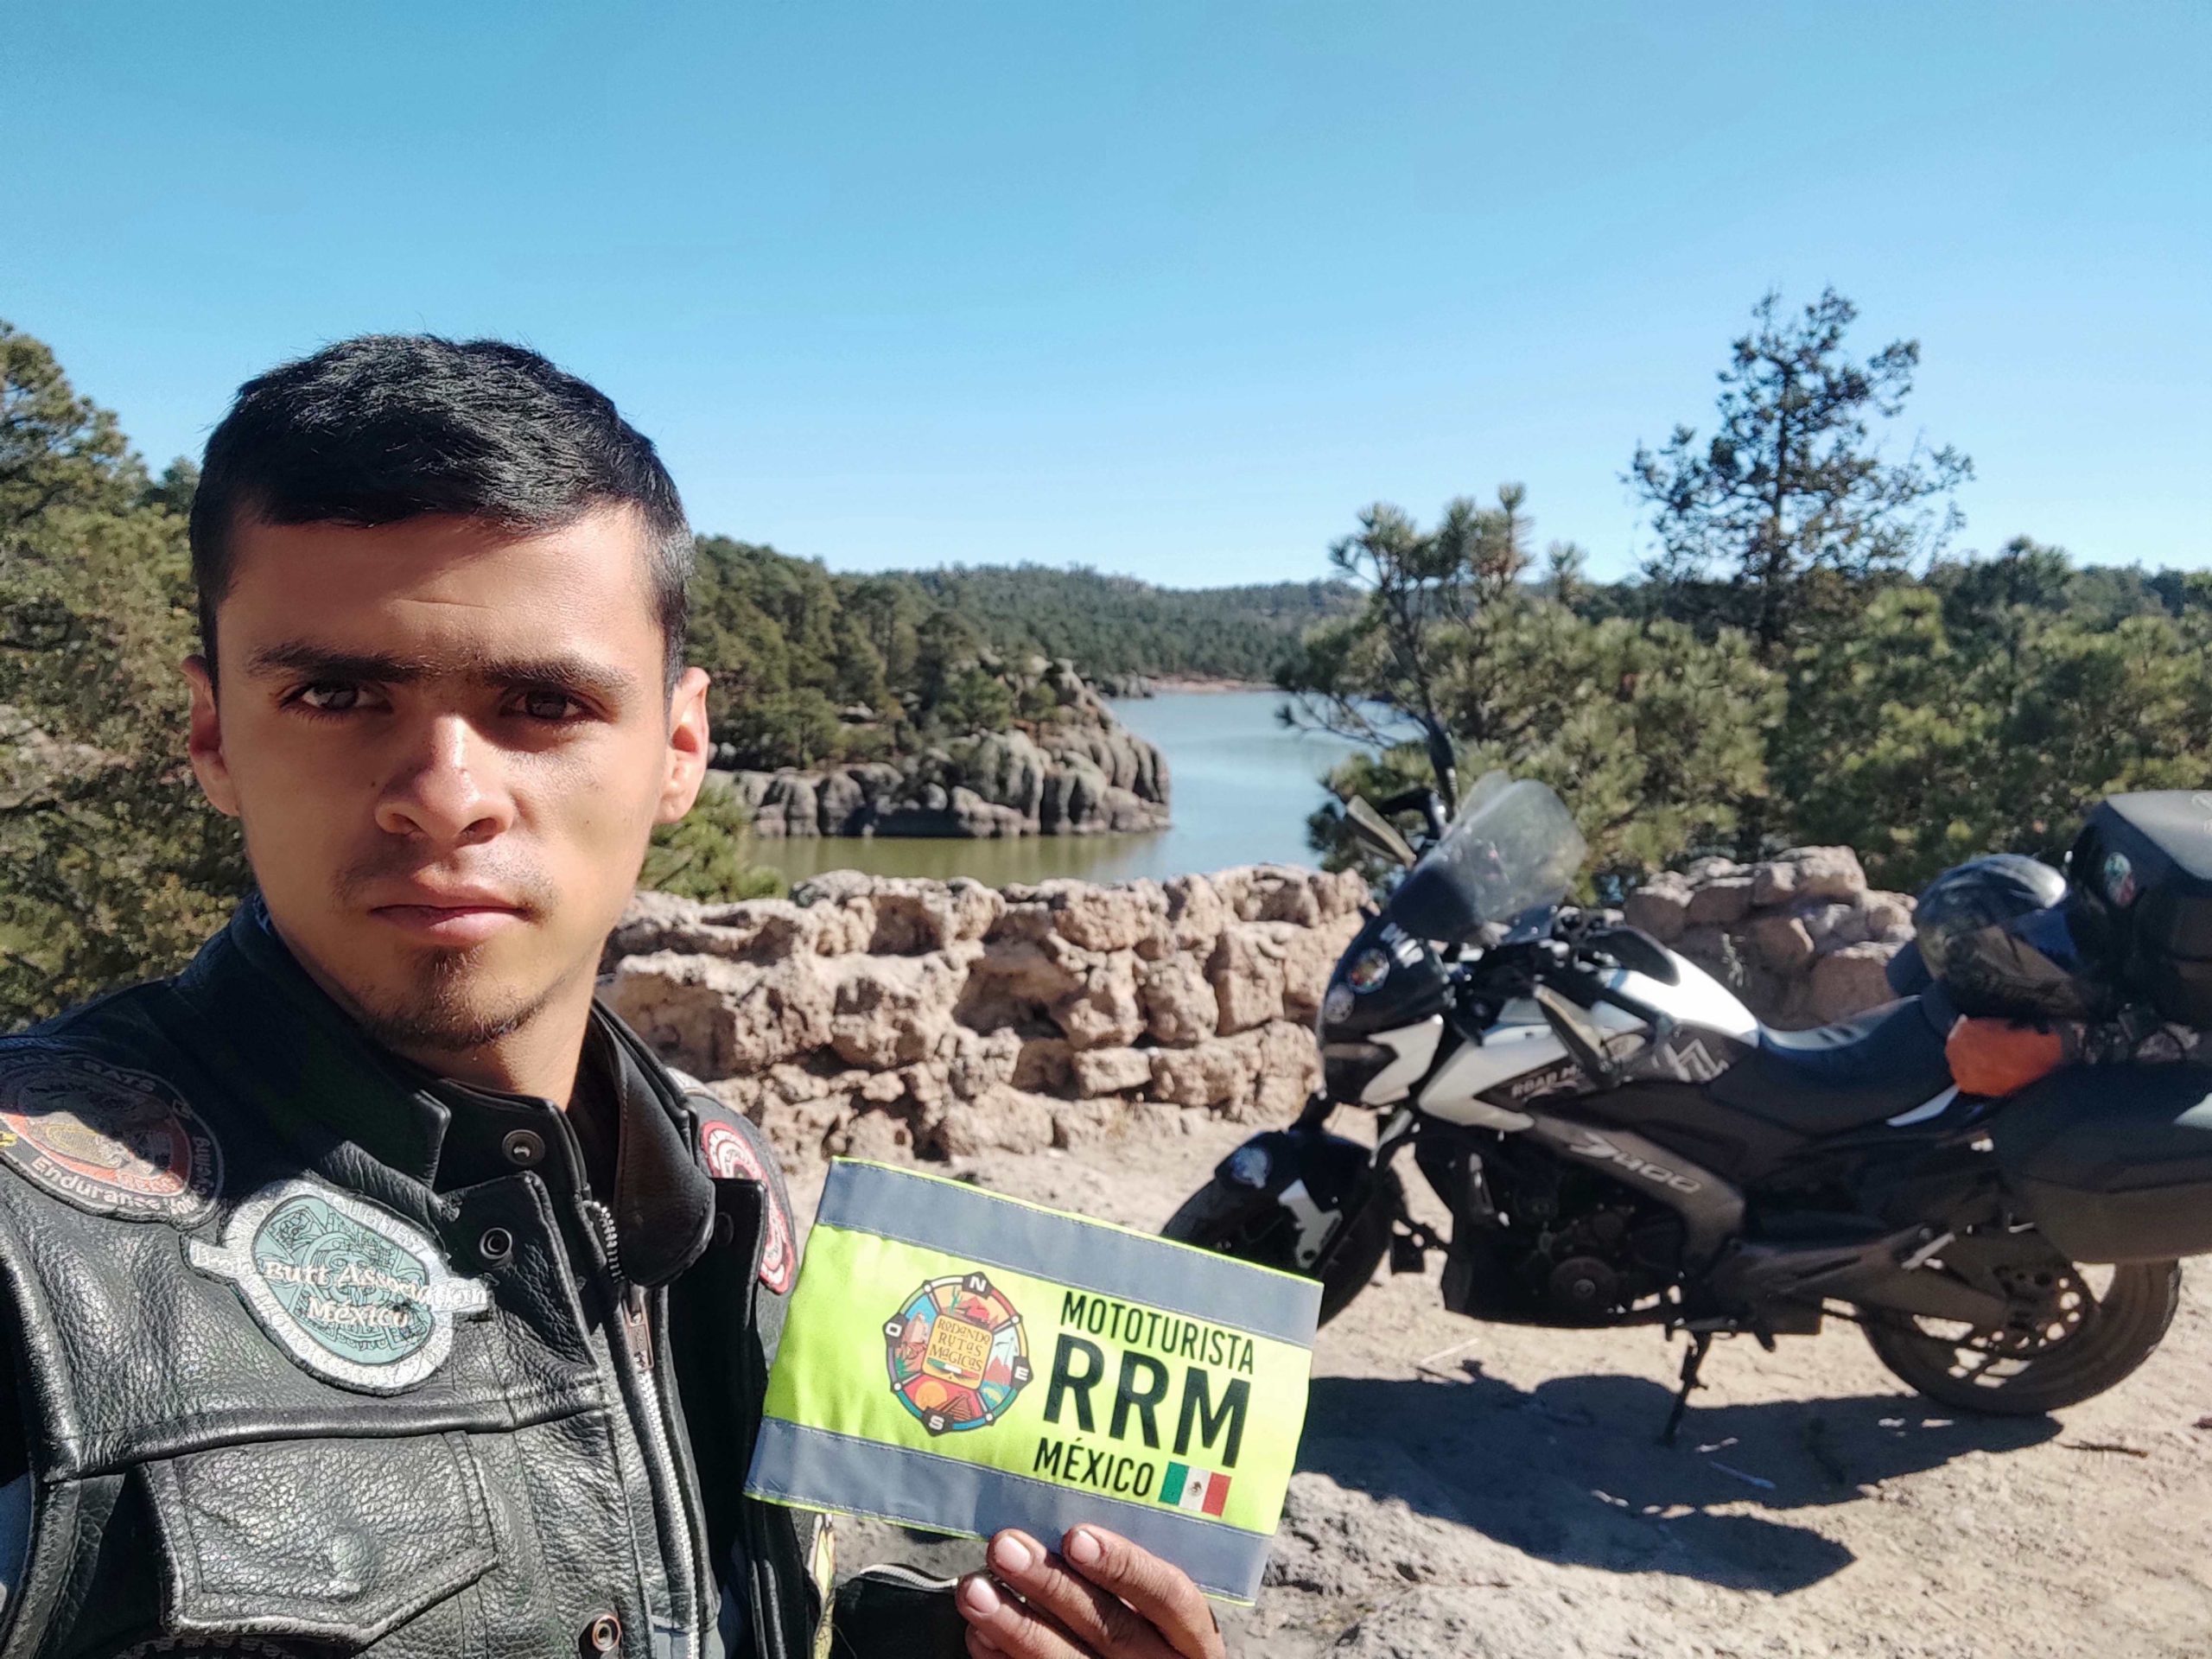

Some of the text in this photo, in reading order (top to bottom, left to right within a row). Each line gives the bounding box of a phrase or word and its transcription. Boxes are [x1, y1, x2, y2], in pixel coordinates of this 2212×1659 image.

[266, 1260, 330, 1287] Butt
[969, 1276, 987, 1292] N
[307, 1294, 410, 1328] México
[885, 1322, 903, 1338] O
[1059, 1291, 1254, 1376] MOTOTURISTA
[1014, 1366, 1029, 1381] E
[1043, 1332, 1251, 1469] RRM
[928, 1415, 944, 1431] S
[1033, 1437, 1155, 1497] MÉXICO
